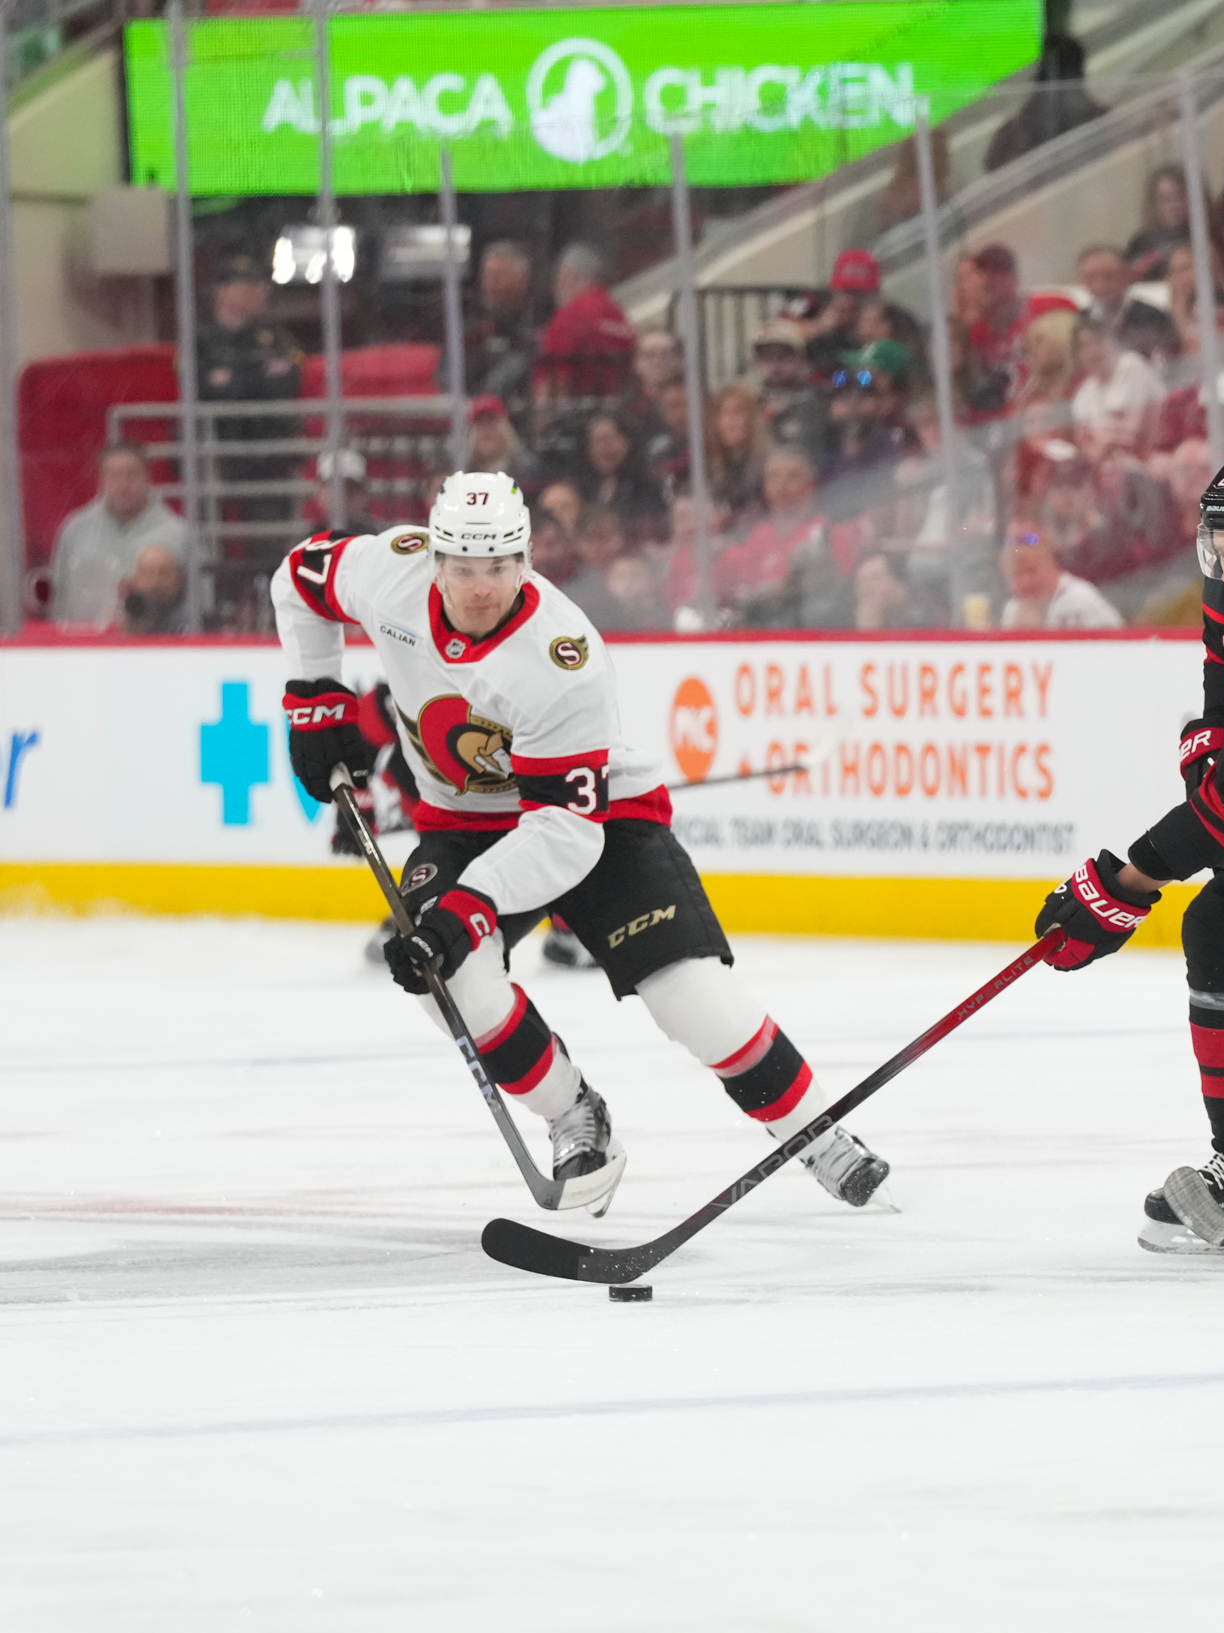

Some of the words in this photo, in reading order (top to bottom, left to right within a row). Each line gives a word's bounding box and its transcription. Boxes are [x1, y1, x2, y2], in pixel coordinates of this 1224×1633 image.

[262, 74, 512, 139] ALPACA
[645, 62, 914, 134] CHICKEN
[466, 492, 489, 506] 37
[380, 625, 416, 647] CALIAN
[734, 663, 838, 717] ORAL
[860, 663, 1054, 718] SURGERY
[1075, 864, 1147, 928] BAUER
[607, 904, 677, 949] CCM
[957, 955, 1034, 1018] HYPRLITE
[710, 1115, 836, 1208] VAPOR
